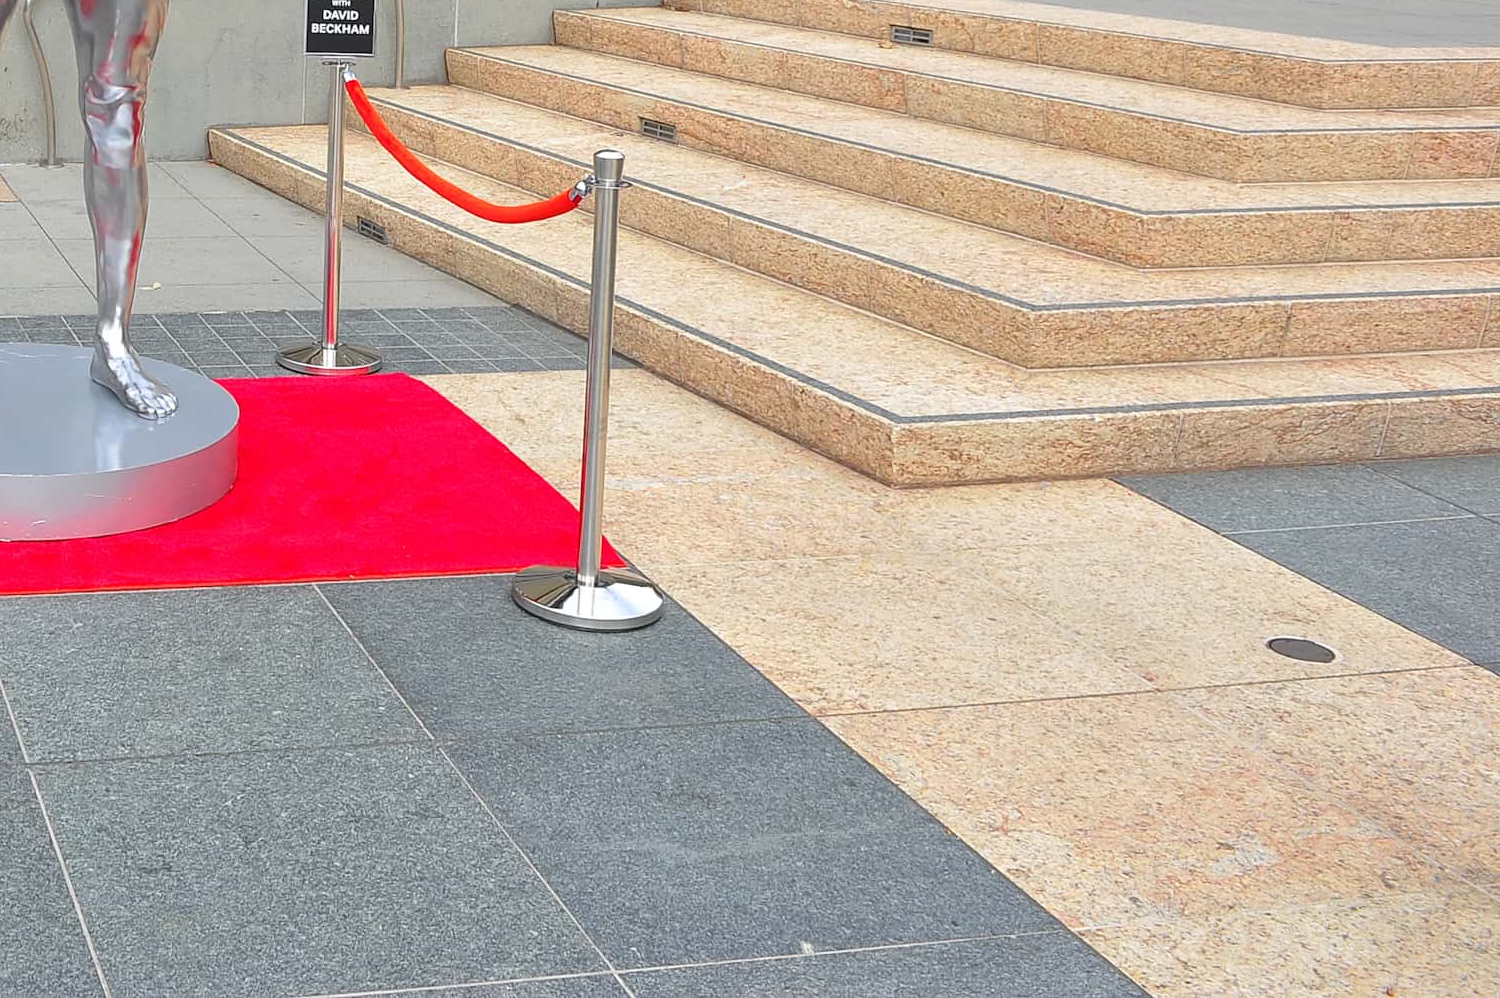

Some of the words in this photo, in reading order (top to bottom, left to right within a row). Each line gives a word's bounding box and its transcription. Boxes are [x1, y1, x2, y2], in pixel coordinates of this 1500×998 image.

[331, 0, 351, 7] WITH
[323, 9, 360, 21] DAVID
[311, 23, 370, 35] BECKHAM
